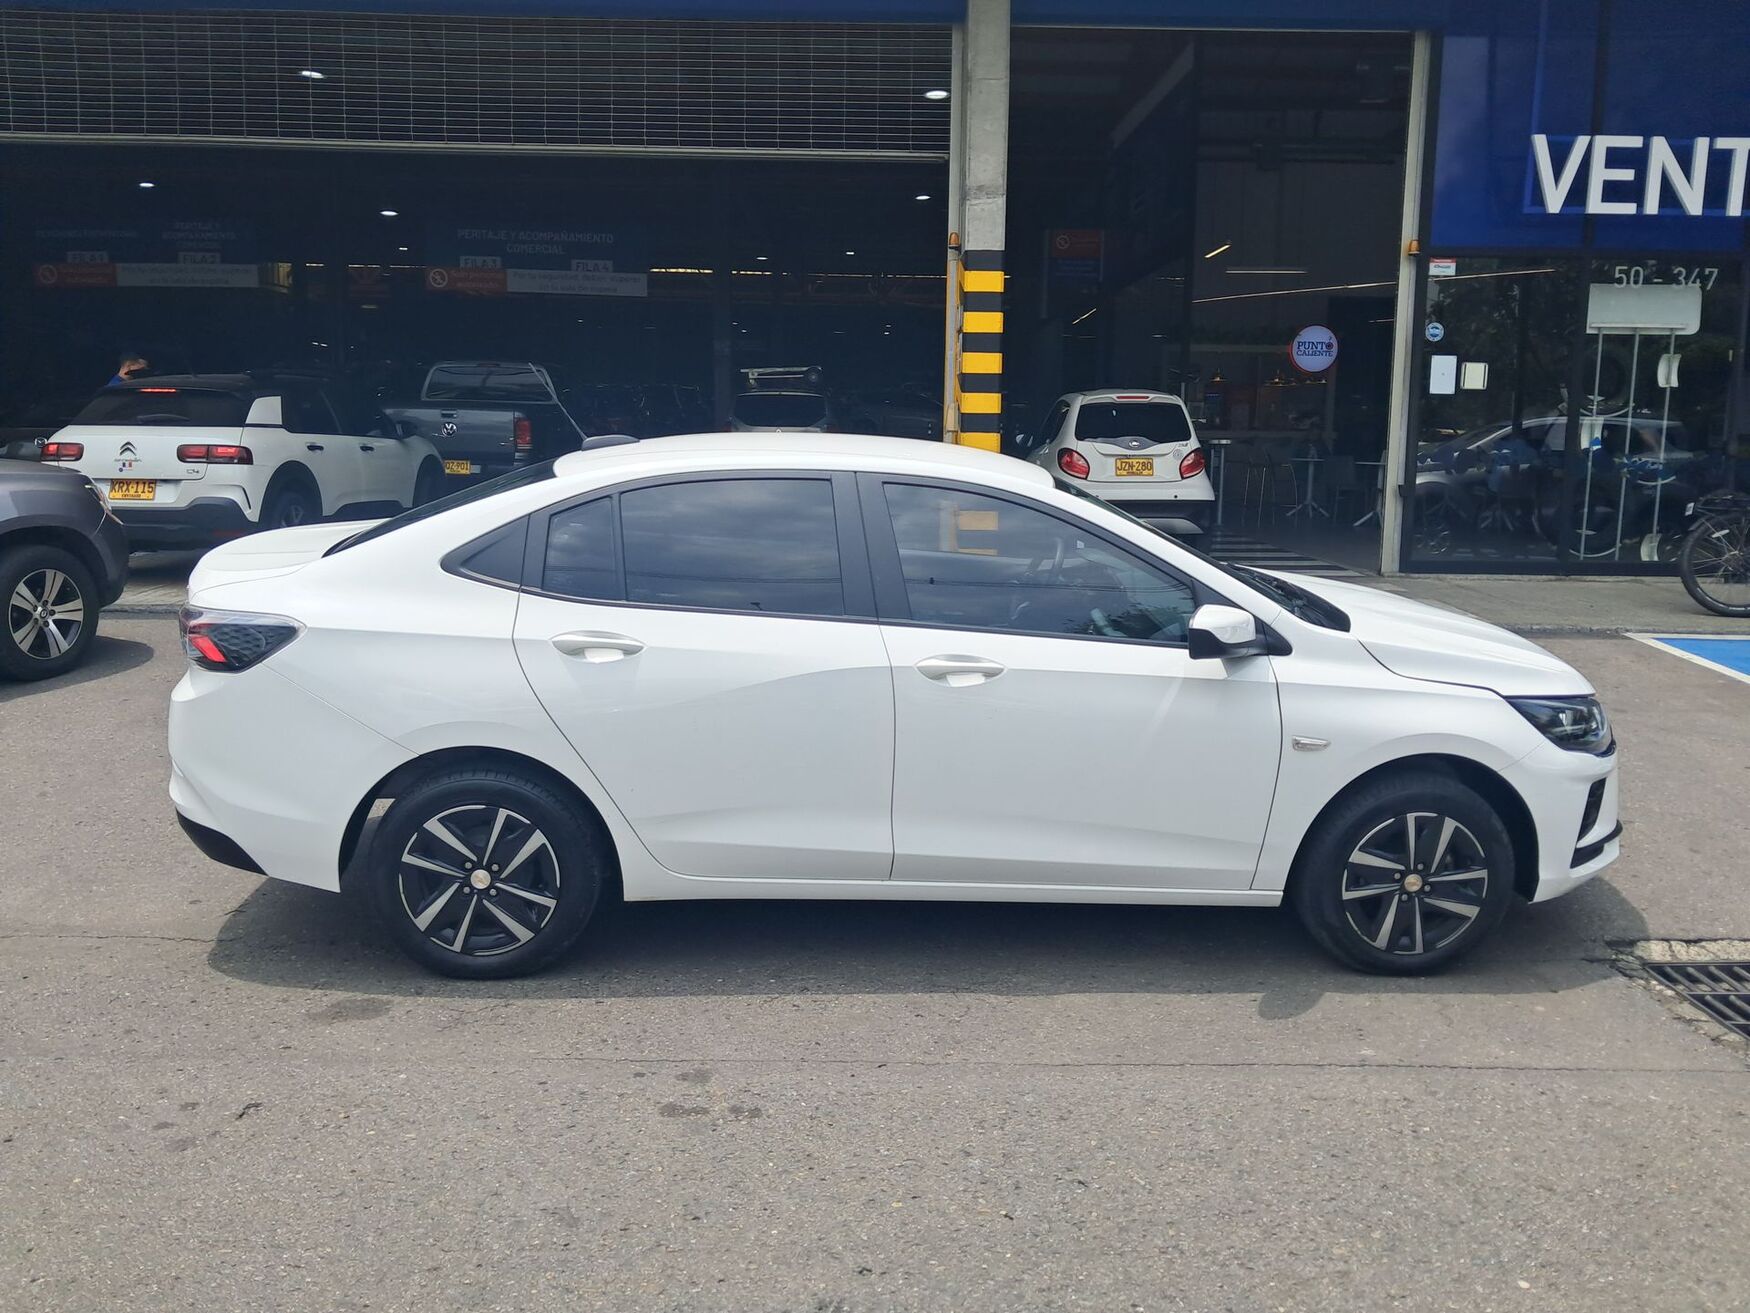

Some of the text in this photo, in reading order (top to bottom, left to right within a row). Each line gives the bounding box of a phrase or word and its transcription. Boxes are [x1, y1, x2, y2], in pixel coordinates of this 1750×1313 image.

[1530, 134, 1750, 217] VENT
[1614, 265, 1644, 289] 50
[1672, 267, 1718, 291] 347
[1297, 341, 1334, 350] PUNTO
[110, 481, 154, 494] KRX-115
